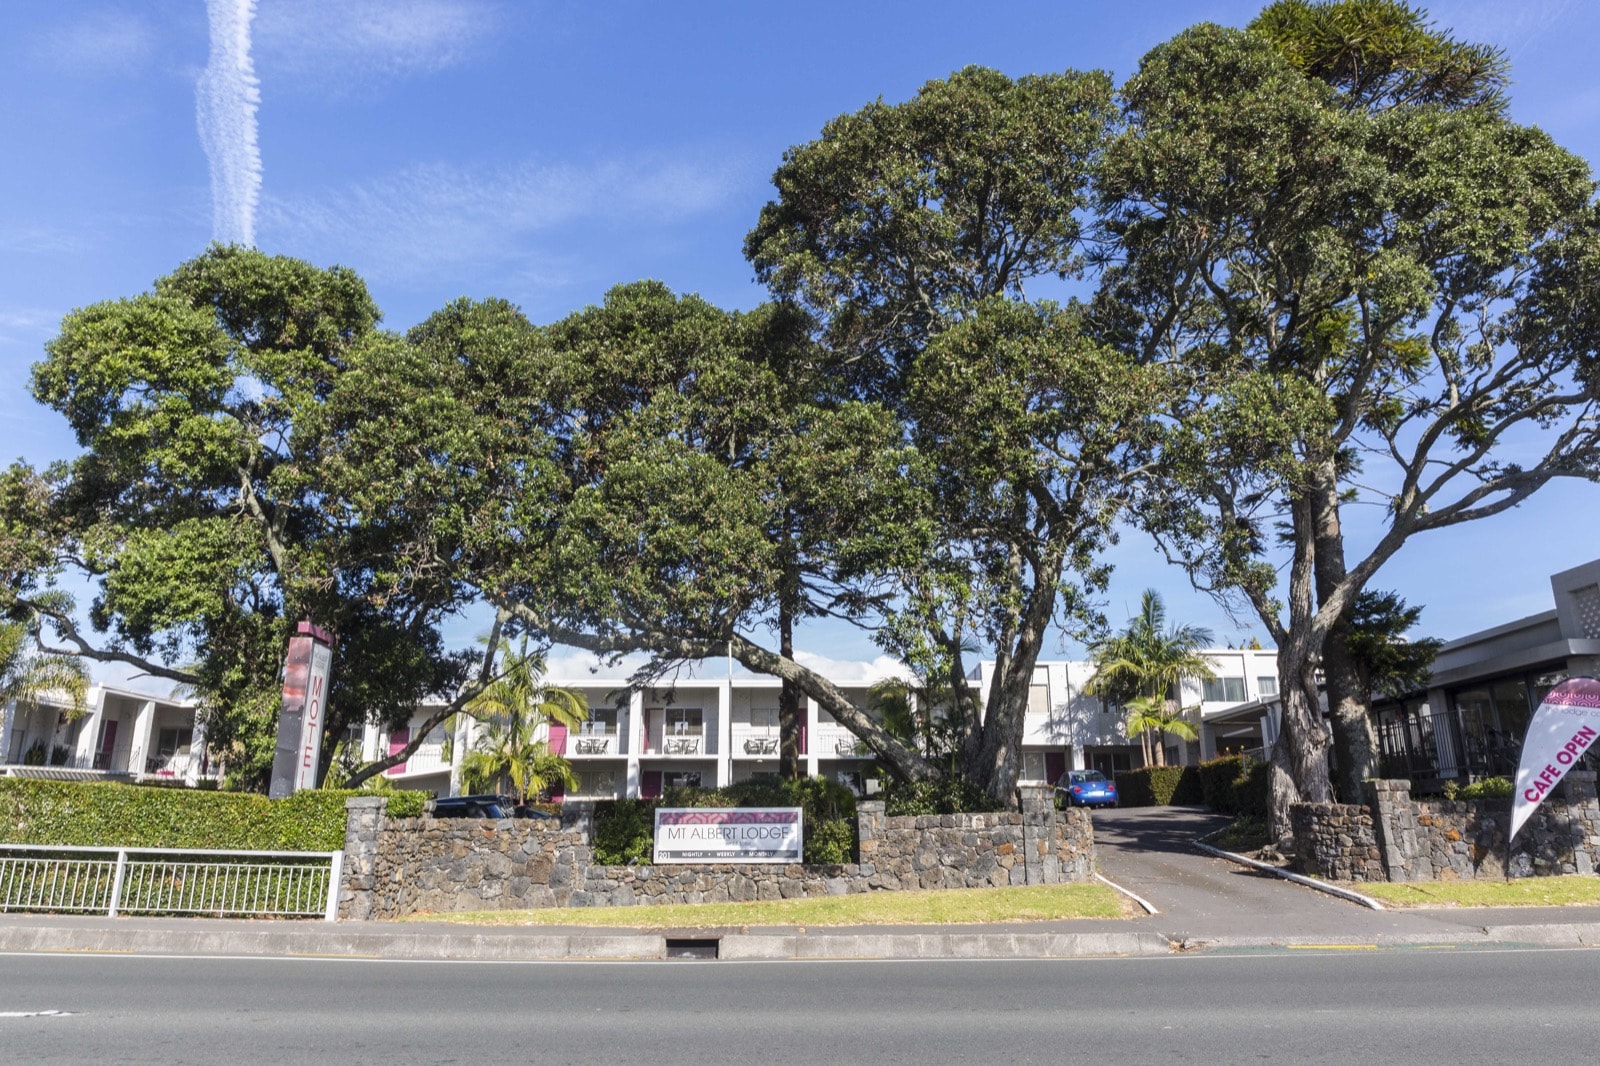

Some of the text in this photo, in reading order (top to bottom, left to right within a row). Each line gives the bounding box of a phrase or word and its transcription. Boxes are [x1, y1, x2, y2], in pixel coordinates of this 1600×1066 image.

[1524, 725, 1597, 802] CAFE OPEN
[668, 826, 789, 840] MT ALBERT LODGE
[658, 851, 671, 859] 201
